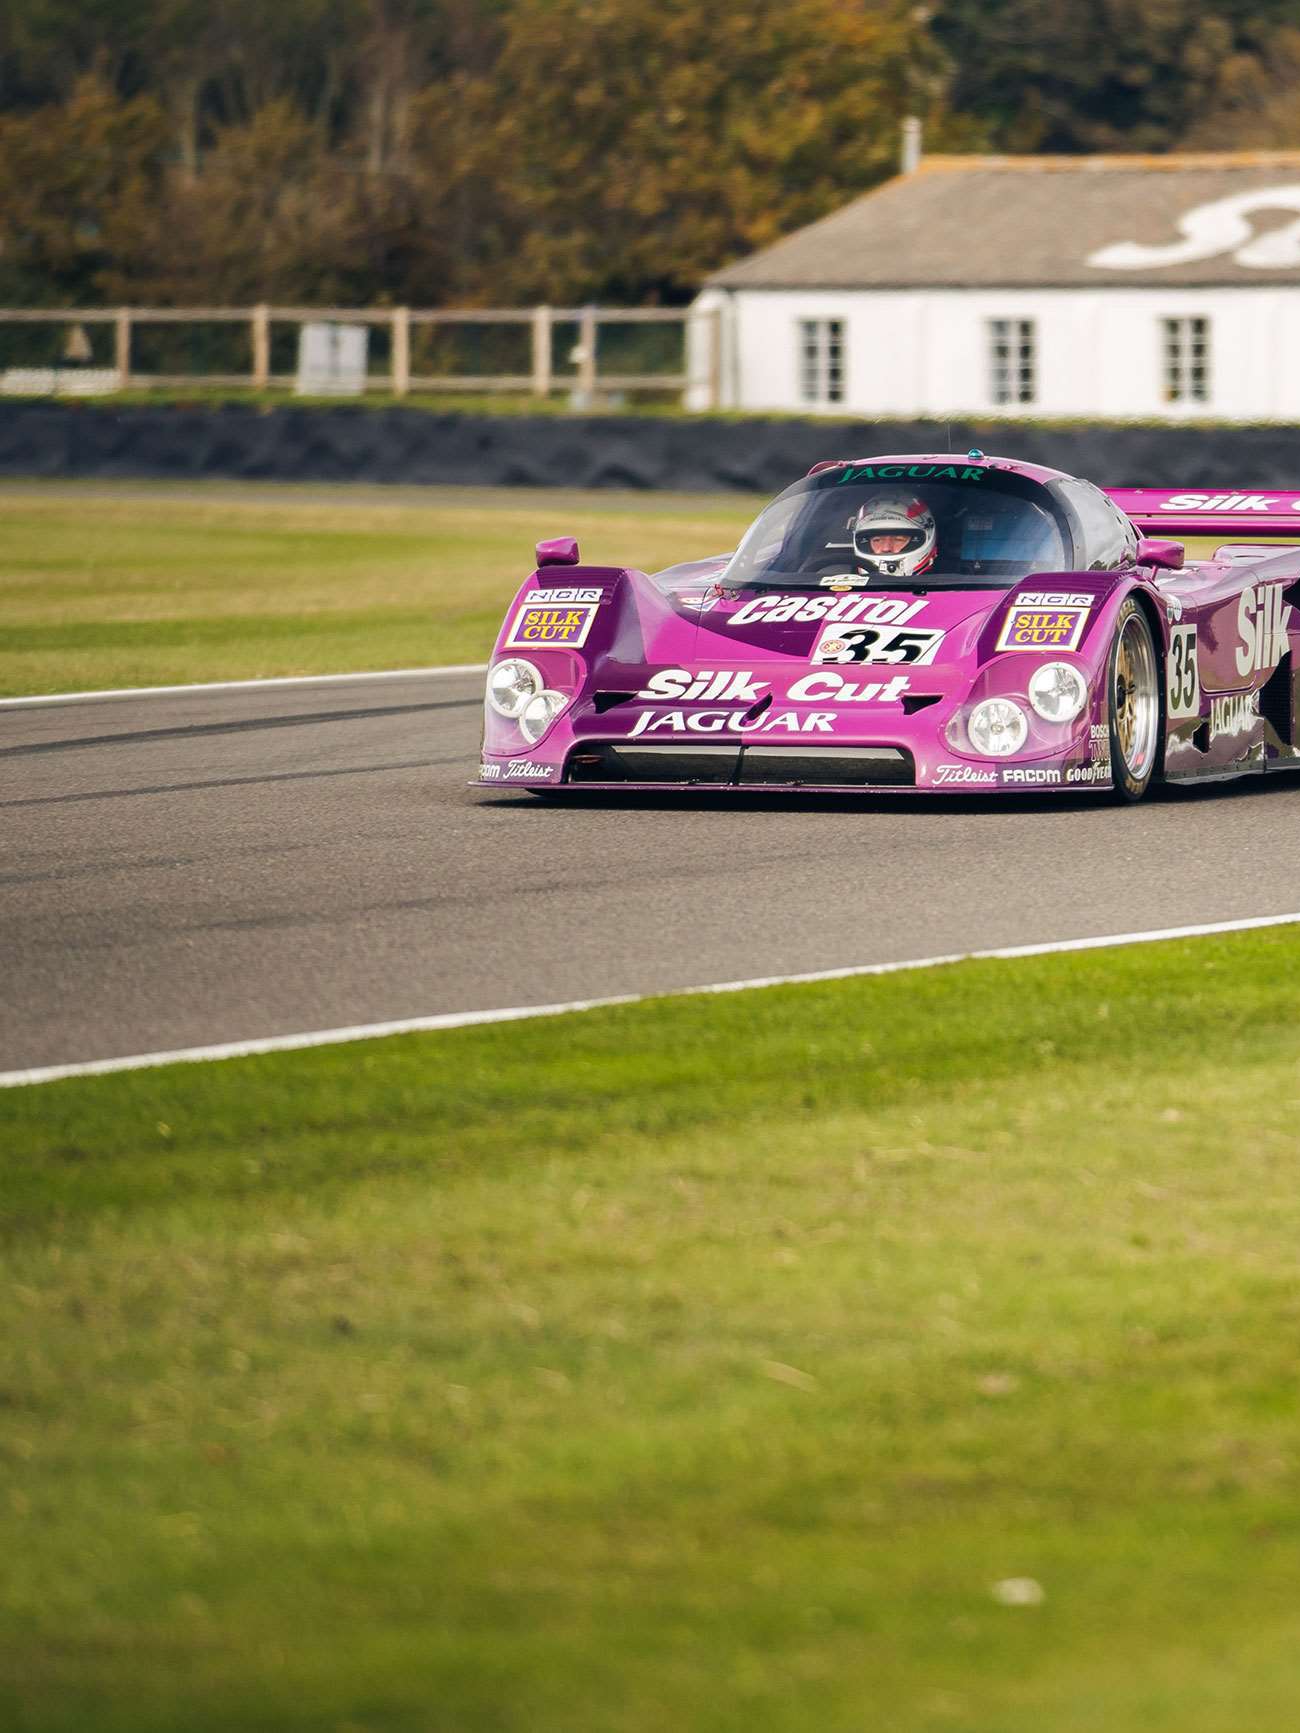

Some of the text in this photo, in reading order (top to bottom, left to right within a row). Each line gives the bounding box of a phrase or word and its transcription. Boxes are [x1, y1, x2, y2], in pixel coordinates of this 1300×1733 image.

[838, 465, 984, 483] JAGUAR
[1160, 494, 1279, 511] Silk
[530, 590, 598, 600] NCR
[1020, 595, 1090, 605] NCR
[524, 610, 584, 625] SILK
[727, 594, 930, 626] Castrol
[1015, 614, 1075, 629] SILK
[1235, 583, 1294, 677] Silk
[523, 625, 577, 640] CUT
[1015, 629, 1068, 643] CUT
[822, 629, 936, 665] 35
[1170, 633, 1197, 710] 35
[637, 669, 912, 702] Silk Cut
[627, 711, 838, 737] JAGUAR
[503, 759, 554, 779] Titleist
[932, 765, 998, 784] Titleist
[1003, 769, 1061, 783] FACOM
